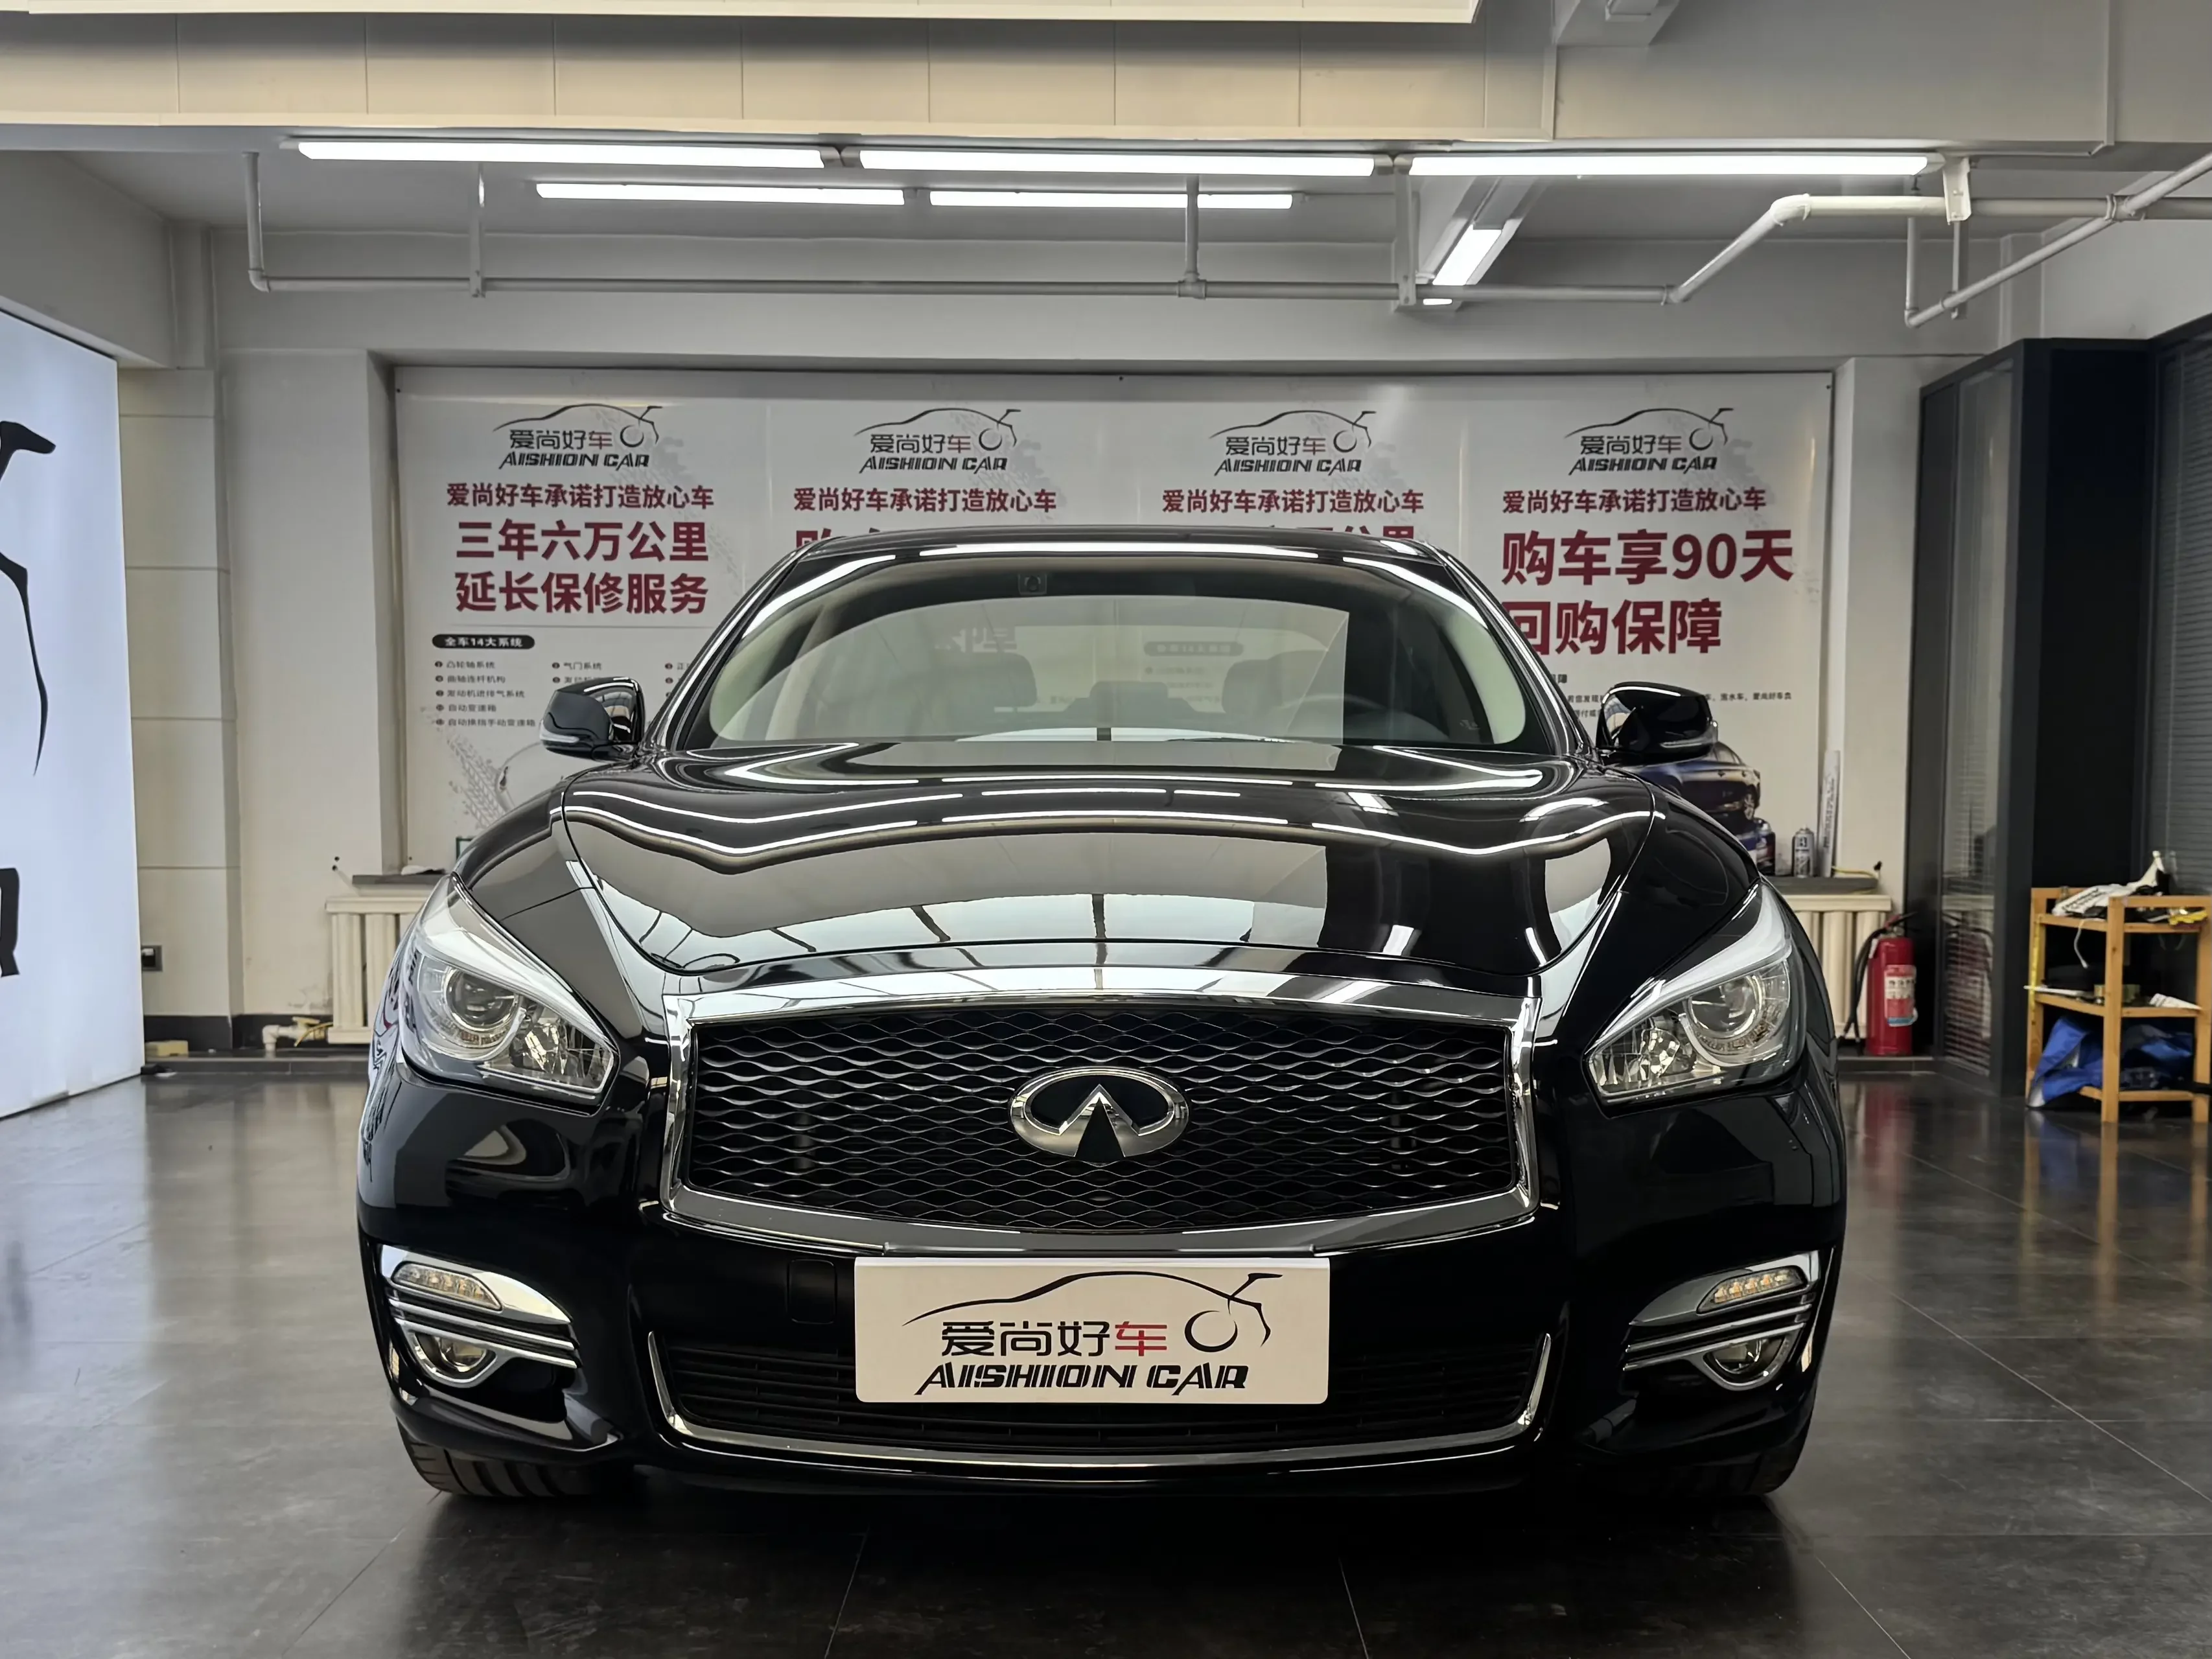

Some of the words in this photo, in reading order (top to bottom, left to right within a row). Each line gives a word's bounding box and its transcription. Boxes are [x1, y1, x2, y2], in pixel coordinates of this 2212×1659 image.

[509, 429, 613, 450] 爱尚好车
[870, 434, 971, 454] 爱尚好车
[1226, 436, 1326, 456] 爱尚好车
[1580, 434, 1682, 455] 爱尚好车
[499, 451, 600, 470] AISHION
[603, 452, 650, 471] CAR
[859, 456, 958, 474] AISHION
[962, 456, 1008, 474] CAR
[1214, 458, 1313, 476] AISHION
[1316, 458, 1362, 476] CAR
[1568, 457, 1668, 476] AISHION
[1671, 456, 1718, 475] CAR
[447, 482, 714, 509] 爱尚好车承诺打造放心车
[793, 487, 1056, 513] 爱尚好车承诺打造放心车
[1162, 488, 1424, 514] 爱尚好车承诺打造放心车
[1502, 486, 1767, 514] 爱尚好车承诺打造放心车
[456, 518, 709, 563] 三年六万公里
[1501, 528, 1794, 585] 购车享90天
[454, 570, 708, 614] 延长保修服务
[1502, 597, 1722, 655] 回购保障
[445, 636, 523, 648] 全车14大系统
[941, 1320, 1168, 1357] 爱尚好车
[914, 1362, 1138, 1395] AISHION
[1146, 1362, 1249, 1396] CAR
